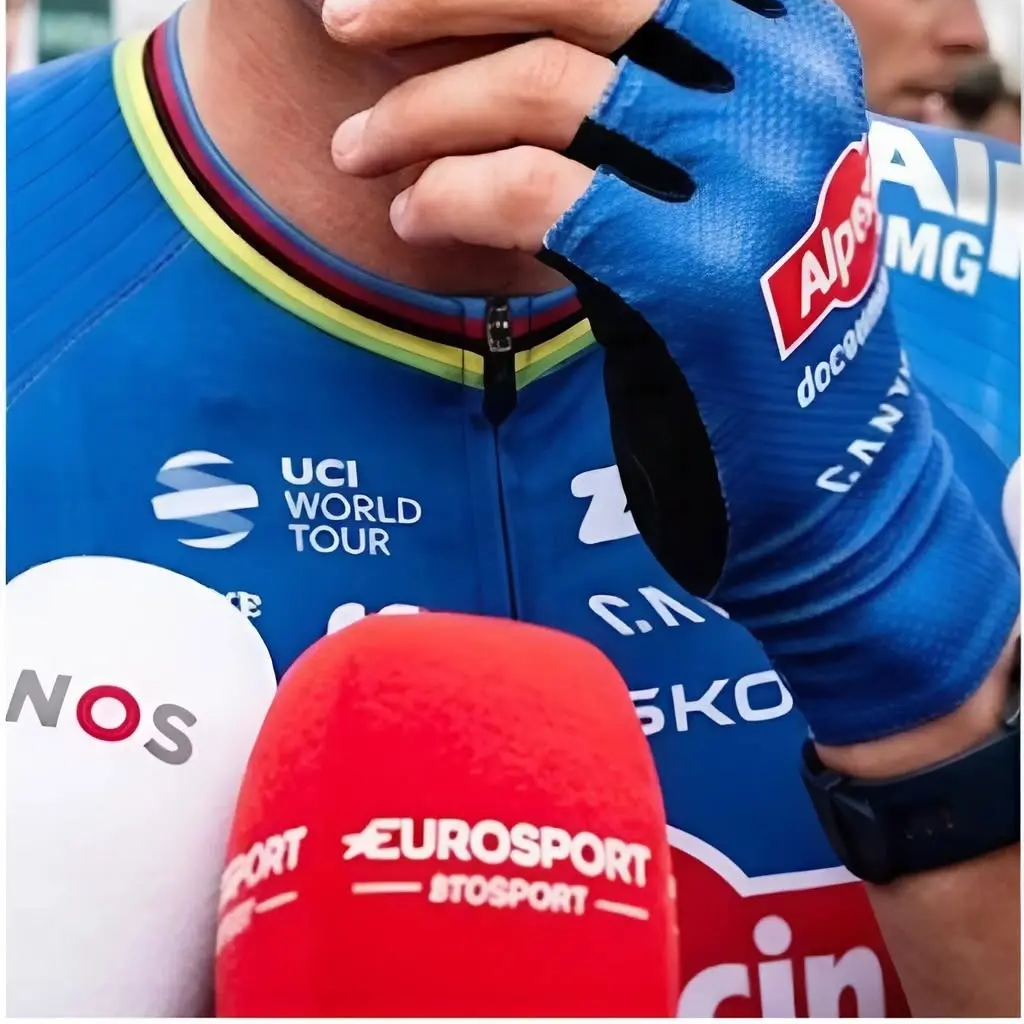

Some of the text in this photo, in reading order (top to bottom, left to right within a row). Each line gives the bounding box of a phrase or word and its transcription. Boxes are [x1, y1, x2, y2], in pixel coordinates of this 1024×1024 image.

[281, 457, 358, 488] UCI
[284, 490, 422, 524] WORLD
[288, 524, 390, 556] TOUR
[5, 669, 197, 765] NOS
